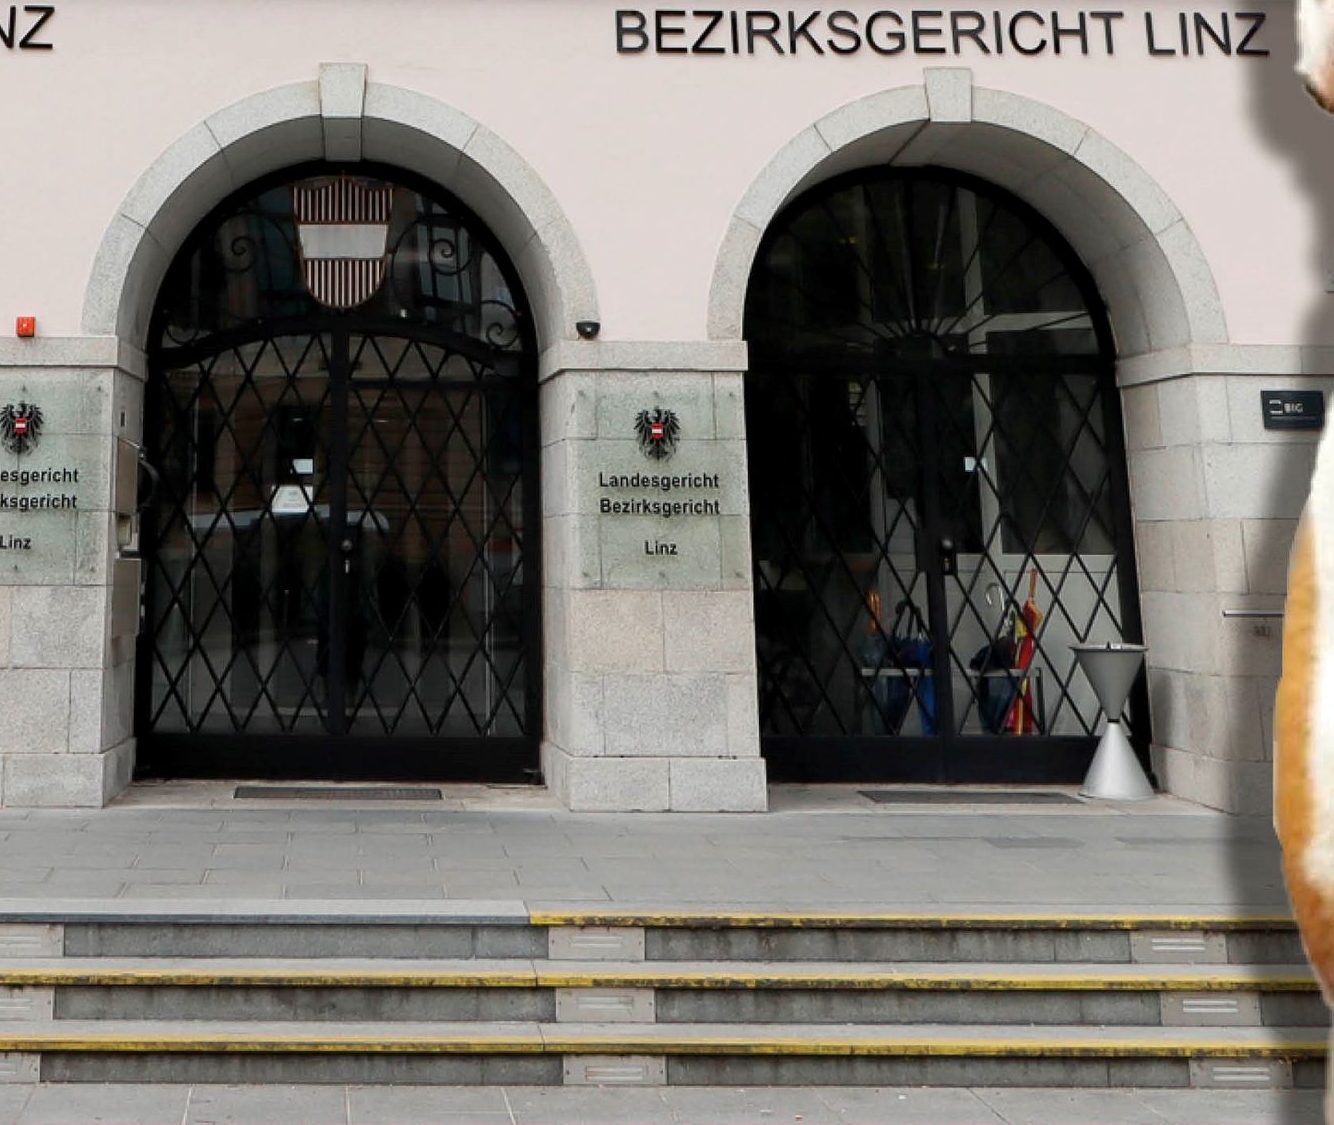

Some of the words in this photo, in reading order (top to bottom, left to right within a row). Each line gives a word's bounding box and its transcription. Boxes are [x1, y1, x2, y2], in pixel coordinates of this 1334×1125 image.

[615, 10, 1124, 56] BEZIRKSGERICHT
[1145, 11, 1269, 57] LINZ
[599, 472, 719, 491] Landesgericht
[600, 498, 720, 518] Bezirksgericht
[644, 540, 678, 556] Linz
